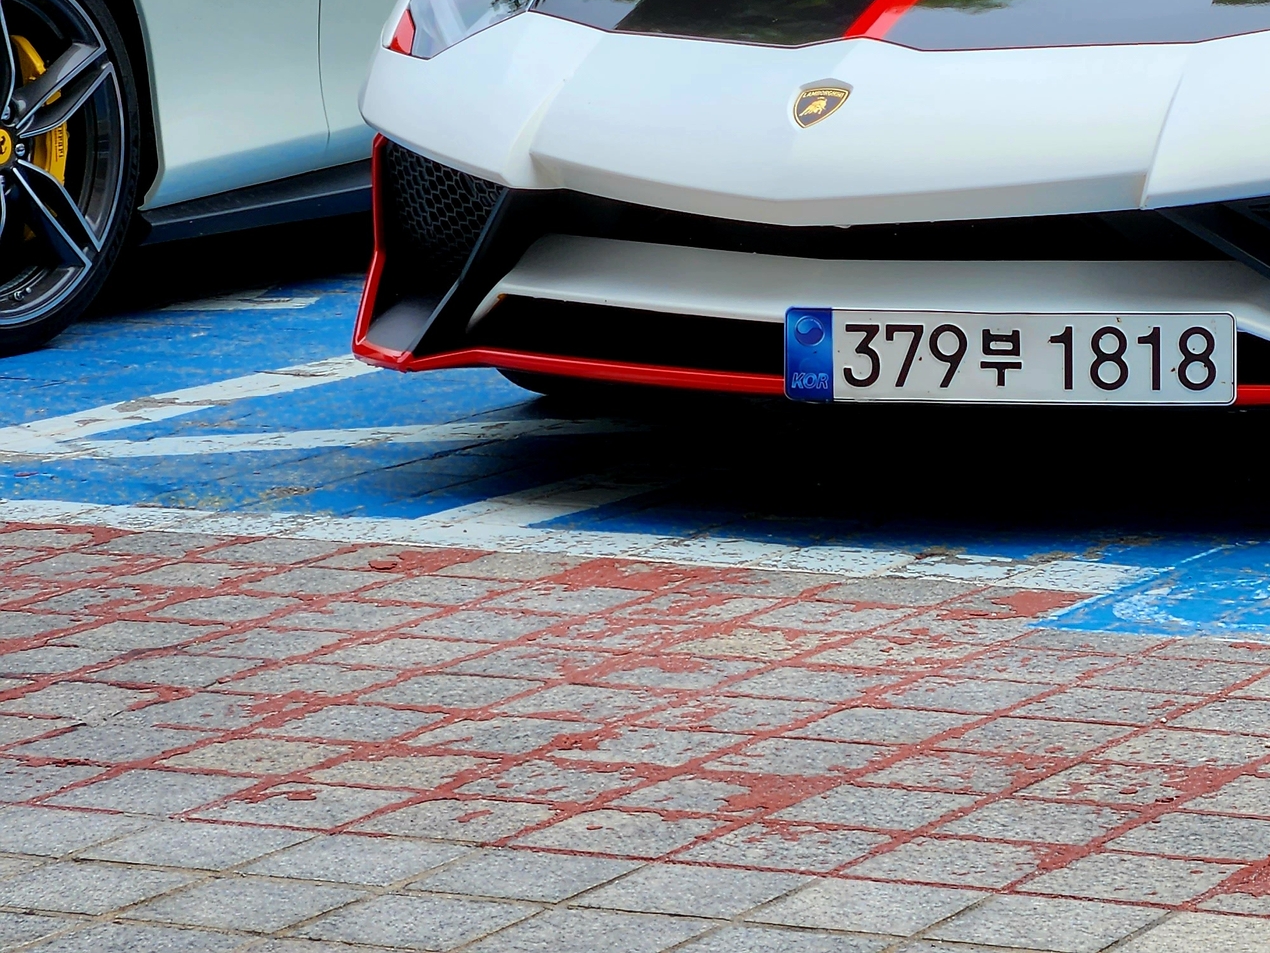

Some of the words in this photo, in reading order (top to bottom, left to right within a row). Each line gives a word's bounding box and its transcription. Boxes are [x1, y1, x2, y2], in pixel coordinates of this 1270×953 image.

[843, 323, 1022, 388] 379부
[1048, 325, 1217, 391] 1818
[791, 372, 829, 389] KOR
